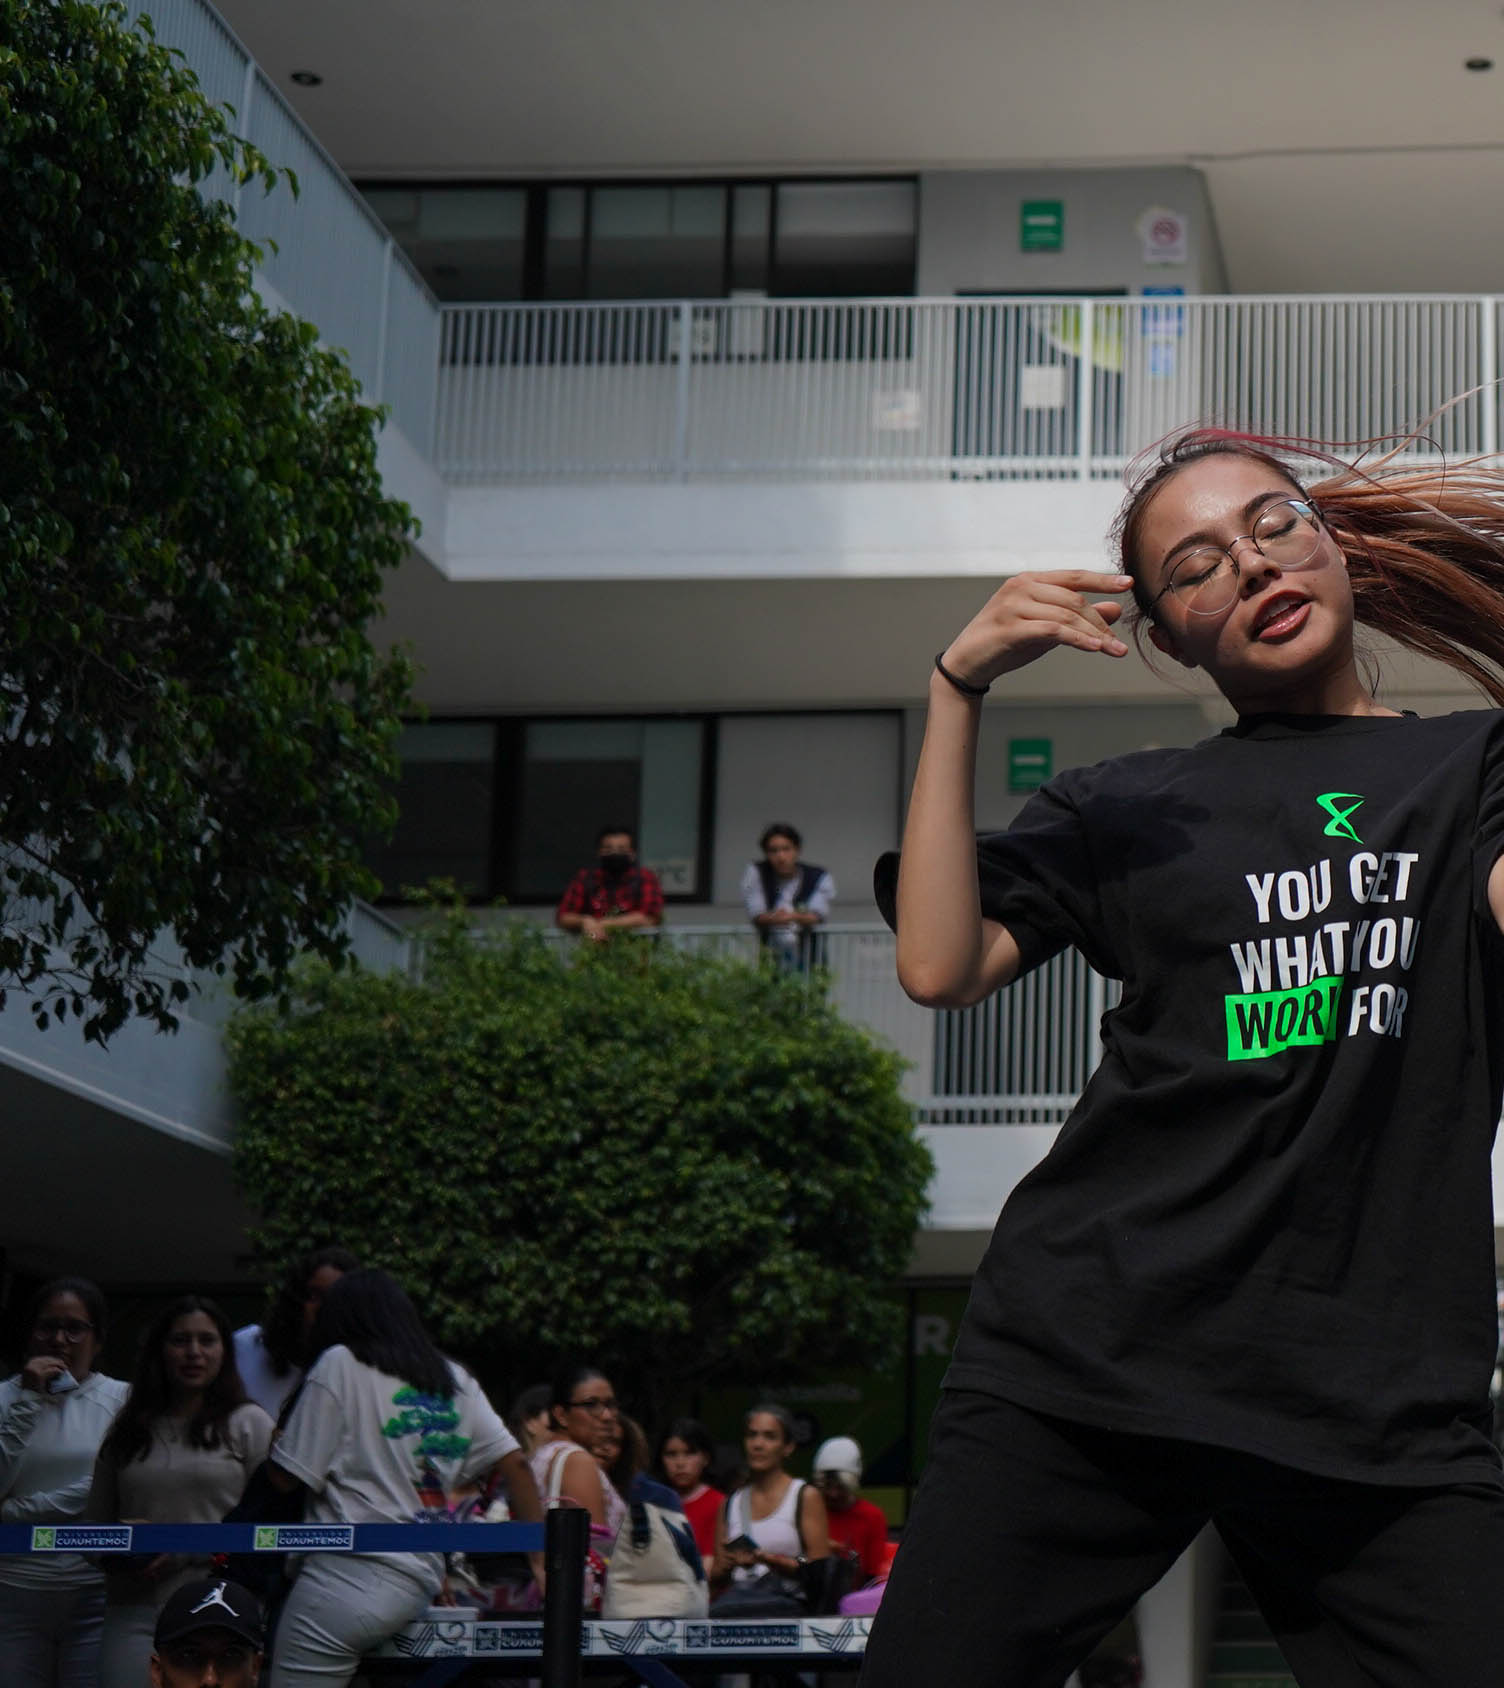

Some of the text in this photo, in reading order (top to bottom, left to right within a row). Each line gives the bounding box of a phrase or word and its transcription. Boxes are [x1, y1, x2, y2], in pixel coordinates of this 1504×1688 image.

[1245, 852, 1419, 923] YOU GET
[1230, 916, 1421, 993] WHAT YOU
[1347, 983, 1409, 1039] FOR
[55, 1537, 129, 1546] CUAUHTEMOC
